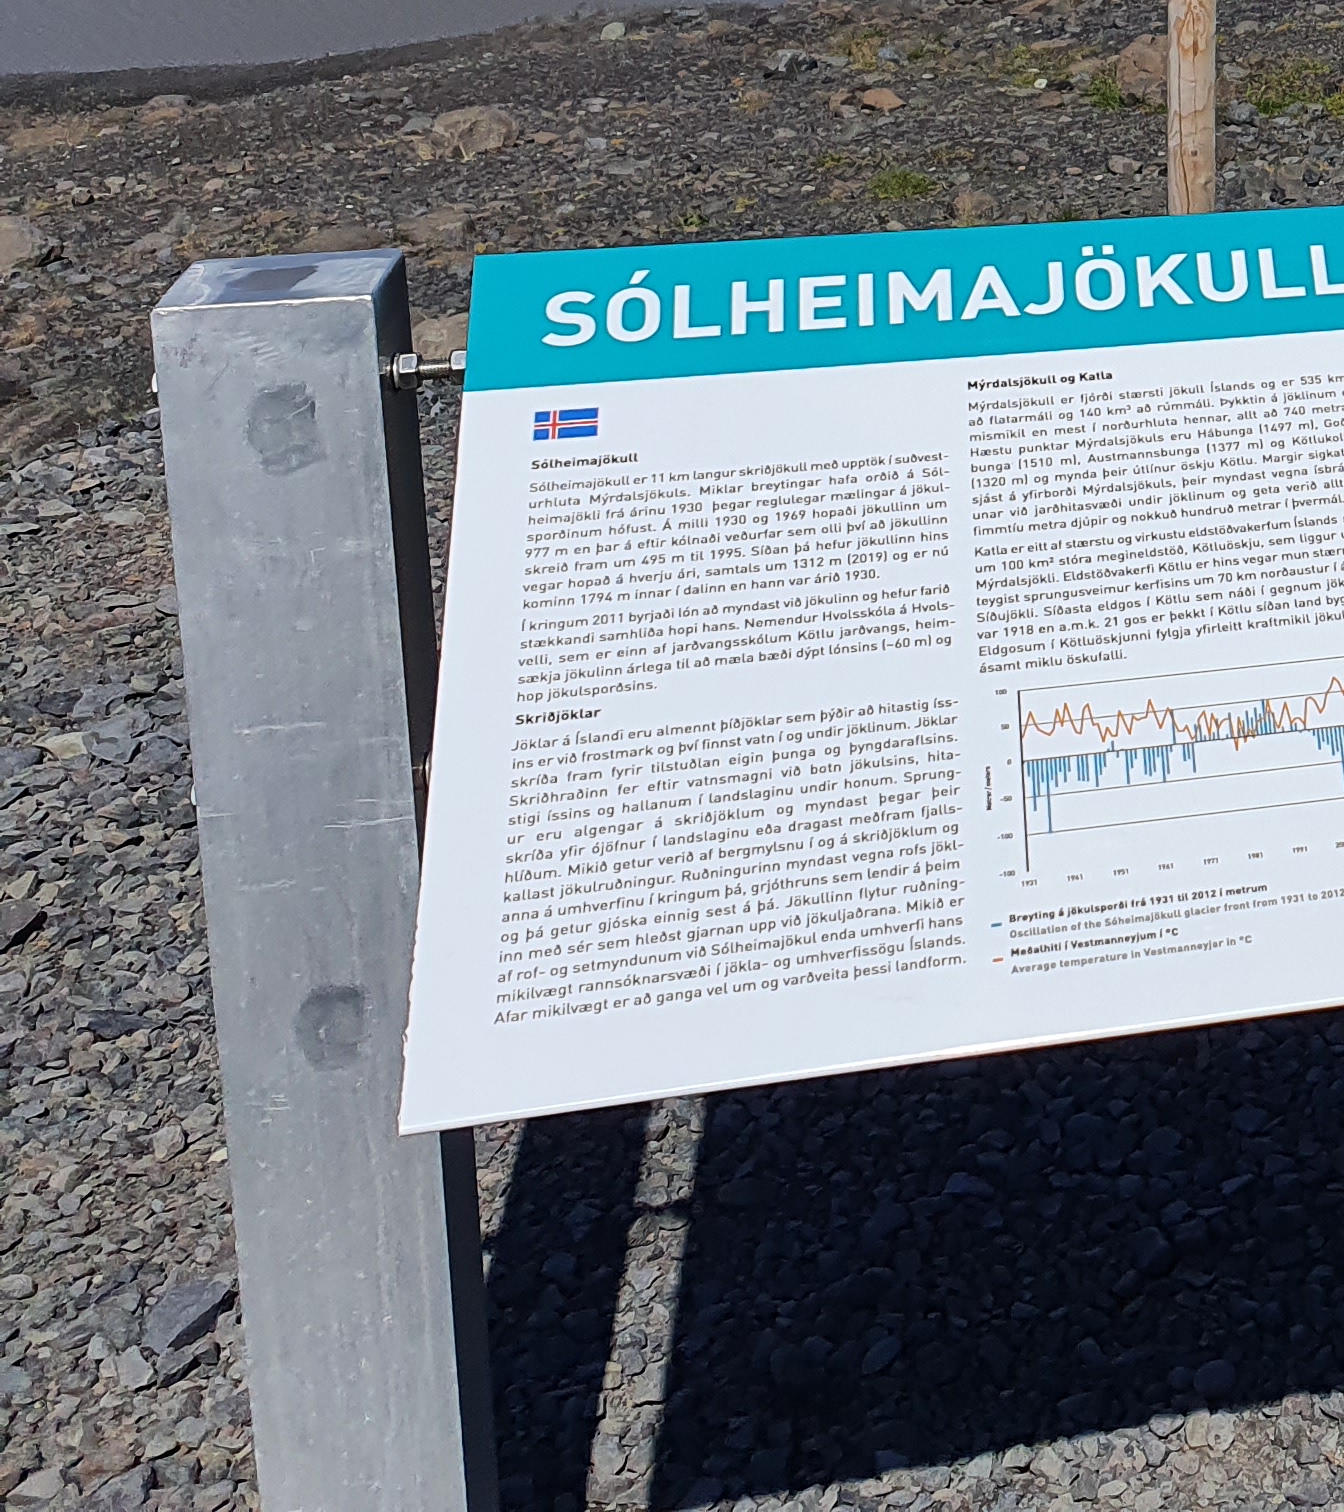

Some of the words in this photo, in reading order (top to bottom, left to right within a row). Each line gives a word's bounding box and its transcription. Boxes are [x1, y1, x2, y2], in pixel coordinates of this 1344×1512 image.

[967, 374, 1057, 392] Mýrdalsjökull
[1059, 375, 1076, 385] og
[1079, 370, 1113, 382] Katla
[970, 446, 1012, 458] Hæstu
[1018, 441, 1070, 456] punktar
[1075, 432, 1165, 451] Mýrdalsjökuls
[1170, 432, 1192, 441] eru
[1197, 427, 1253, 439] Hábunga
[1258, 421, 1292, 435] (1497
[1298, 418, 1319, 431] m),
[529, 475, 630, 493] Sólheimajökull
[633, 476, 649, 485] er
[651, 472, 664, 484] 11
[668, 471, 690, 483] km
[692, 469, 737, 482] langur
[738, 461, 808, 477] skriðjökull
[810, 459, 839, 472] með
[841, 455, 886, 471] upptök
[897, 452, 950, 464] suðvest-
[531, 452, 639, 470] Sólheimajökull
[978, 642, 1046, 658] Eldgosum
[1059, 629, 1151, 649] Kötluöskjunni
[1156, 625, 1192, 642] fylgja
[1195, 621, 1243, 638] yfirleitt
[1246, 613, 1311, 630] kraftmikil
[515, 708, 602, 726] Skriðjöklar
[509, 787, 608, 807] Skriðhraðinn
[617, 783, 640, 796] fer
[647, 778, 680, 792] eftir
[686, 767, 773, 788] vatnsmagni
[780, 765, 802, 778] við
[810, 762, 842, 775] botn
[849, 754, 919, 774] jökulsins,
[927, 749, 961, 763] hita-
[1008, 910, 1056, 924] Breyting
[1057, 907, 1065, 917] á
[1066, 900, 1128, 919] jökulsporði
[1130, 897, 1147, 908] frá
[1149, 894, 1174, 906] 1931
[1177, 892, 1189, 903] til
[1191, 889, 1217, 901] 2012
[1225, 884, 1268, 896] metrum
[1010, 942, 1062, 958] Meðalhiti
[1070, 932, 1157, 950] Vestmanneyjum
[493, 1009, 529, 1025] Afar
[532, 998, 609, 1020] mikilvægt
[612, 997, 631, 1009] er
[633, 992, 652, 1006] að
[656, 988, 702, 1007] ganga
[706, 981, 728, 997] vel
[732, 981, 757, 993] um
[760, 978, 779, 992] og
[782, 967, 849, 986] varðveita
[853, 960, 892, 981] þessi
[895, 955, 967, 972] landform.
